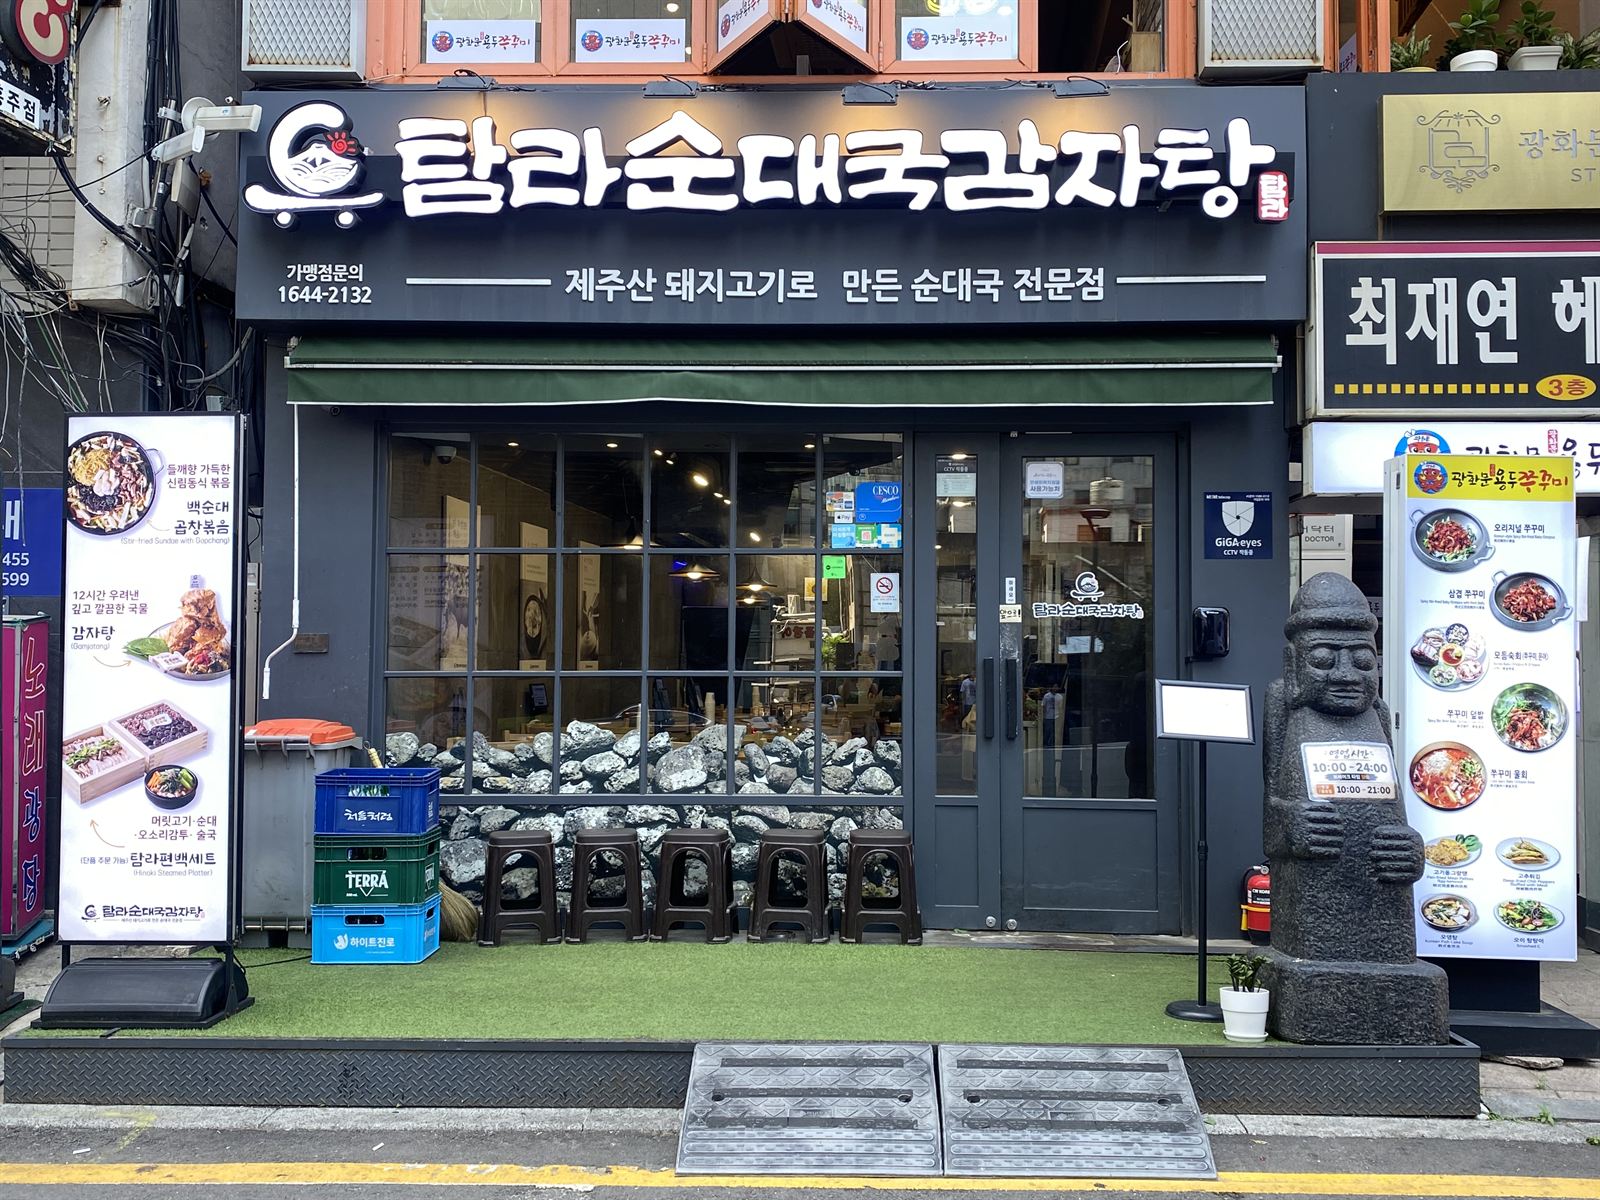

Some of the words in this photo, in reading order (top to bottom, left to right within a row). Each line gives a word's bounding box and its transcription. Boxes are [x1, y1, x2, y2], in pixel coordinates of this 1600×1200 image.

[394, 110, 1276, 219] 탐라순대국감자탕
[1570, 167, 1600, 183] ST
[286, 263, 364, 282] 가맹점문의
[565, 267, 657, 303] 제주산
[664, 267, 818, 303] 돼지고기로
[842, 268, 902, 303] 만든
[911, 268, 1004, 303] 순대국
[1013, 267, 1105, 303] 전문점
[277, 286, 373, 304] 1644-2132
[1345, 276, 1519, 366] 최재연
[1547, 378, 1588, 397] 3층
[167, 464, 198, 476] 들깨향
[200, 464, 230, 476] 가득한
[167, 477, 208, 489] 신림동식
[209, 477, 231, 489] 볶음
[872, 485, 899, 496] CESCO
[187, 500, 230, 515] 백순대
[174, 519, 230, 535] 곱창볶음
[1494, 523, 1522, 534] 오리지널
[1523, 524, 1545, 534] 쭈꾸미
[1304, 535, 1335, 543] DOCTOR
[2, 552, 30, 566] 455
[2, 572, 30, 586] 599
[73, 590, 106, 601] 12시간
[109, 590, 139, 601] 우려낸
[72, 603, 92, 614] 깊고
[94, 603, 125, 614] 깔끔한
[128, 603, 149, 614] 국물
[1033, 602, 1142, 618] 탐라순대국감자탕
[71, 625, 116, 641] 감자탕
[1329, 748, 1369, 759] 영업시간
[1312, 762, 1347, 773] 10:00
[1355, 761, 1388, 774] 24:00
[1336, 785, 1361, 794] 10:00
[1367, 786, 1391, 794] 21:00
[344, 808, 393, 821] 처음처럼
[196, 829, 217, 841] 술국
[130, 852, 216, 867] 탐라편백세트
[345, 869, 389, 889] TERRA
[102, 904, 203, 918] 탐라순대국감자탕
[350, 936, 396, 948] 하이트진로
